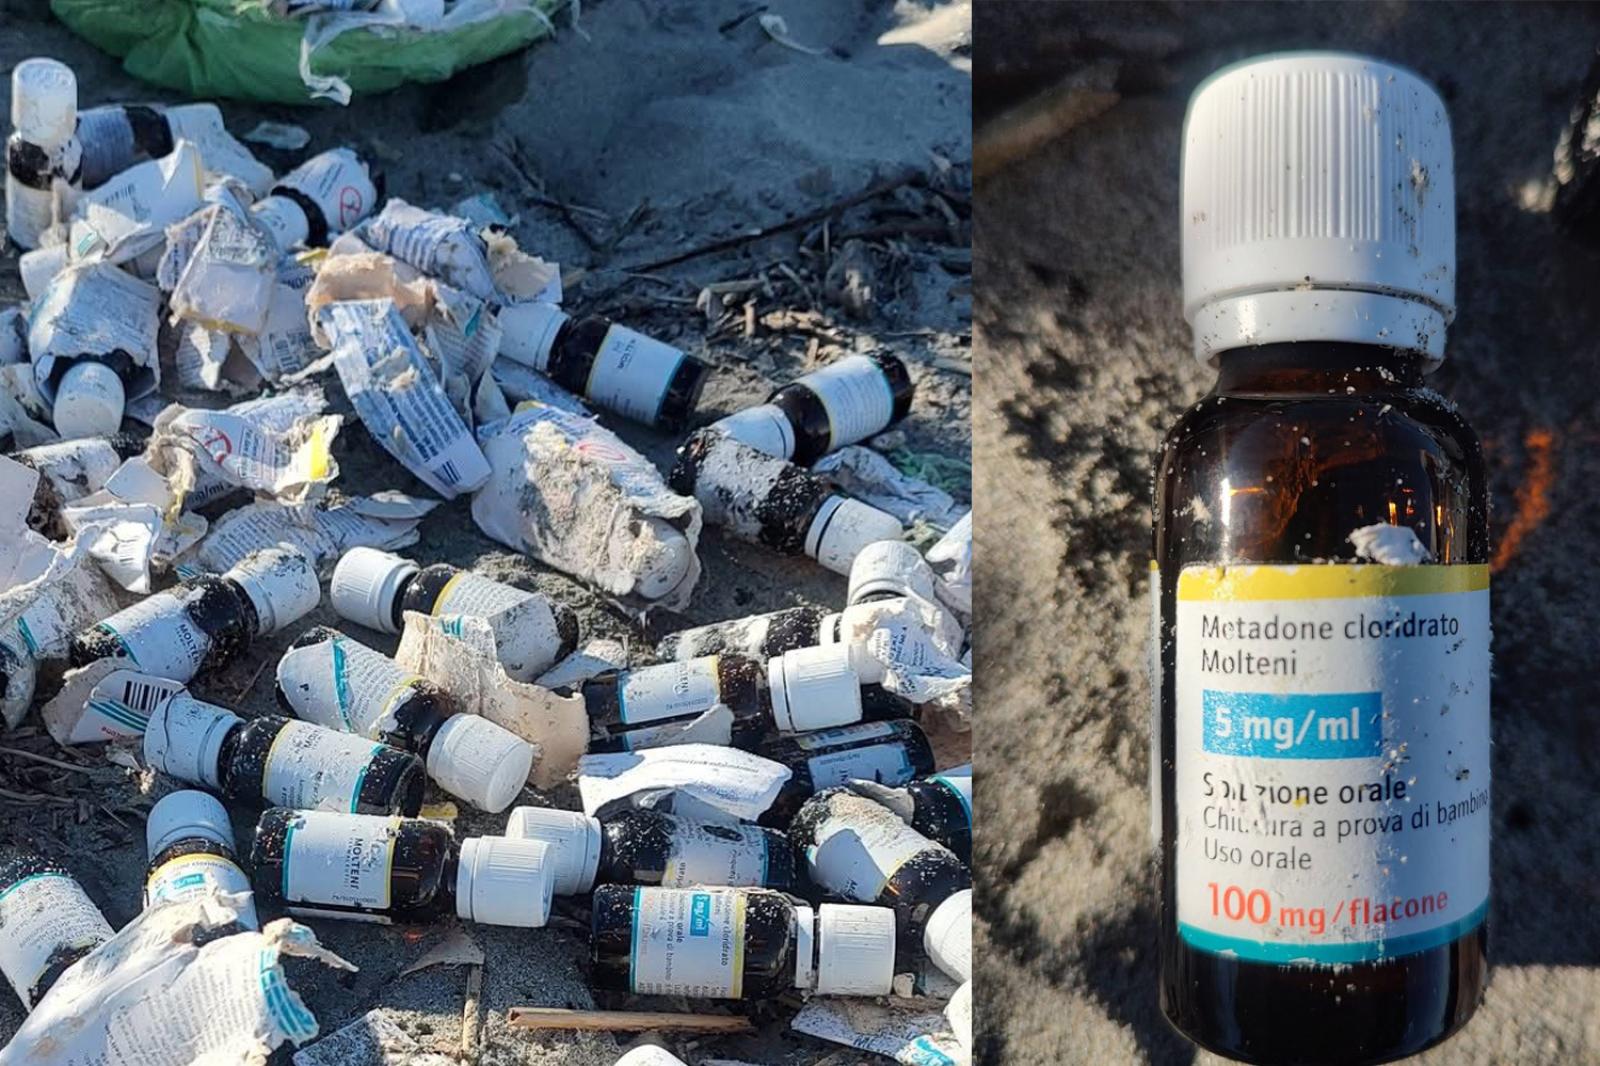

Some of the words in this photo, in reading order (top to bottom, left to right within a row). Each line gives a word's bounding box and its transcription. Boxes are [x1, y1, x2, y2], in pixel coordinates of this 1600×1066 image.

[1202, 614, 1333, 640] Metadone
[1344, 612, 1460, 639] cloridrato
[1202, 648, 1297, 675] Molteni
[1214, 707, 1232, 738] 5
[1243, 706, 1360, 749] mg/ml
[1339, 774, 1407, 804] orale
[1313, 819, 1325, 838] a
[1337, 814, 1403, 843] prova
[1411, 803, 1429, 829] di
[1204, 836, 1242, 864] Uso
[1250, 846, 1313, 870] orale
[1208, 881, 1272, 926] 100
